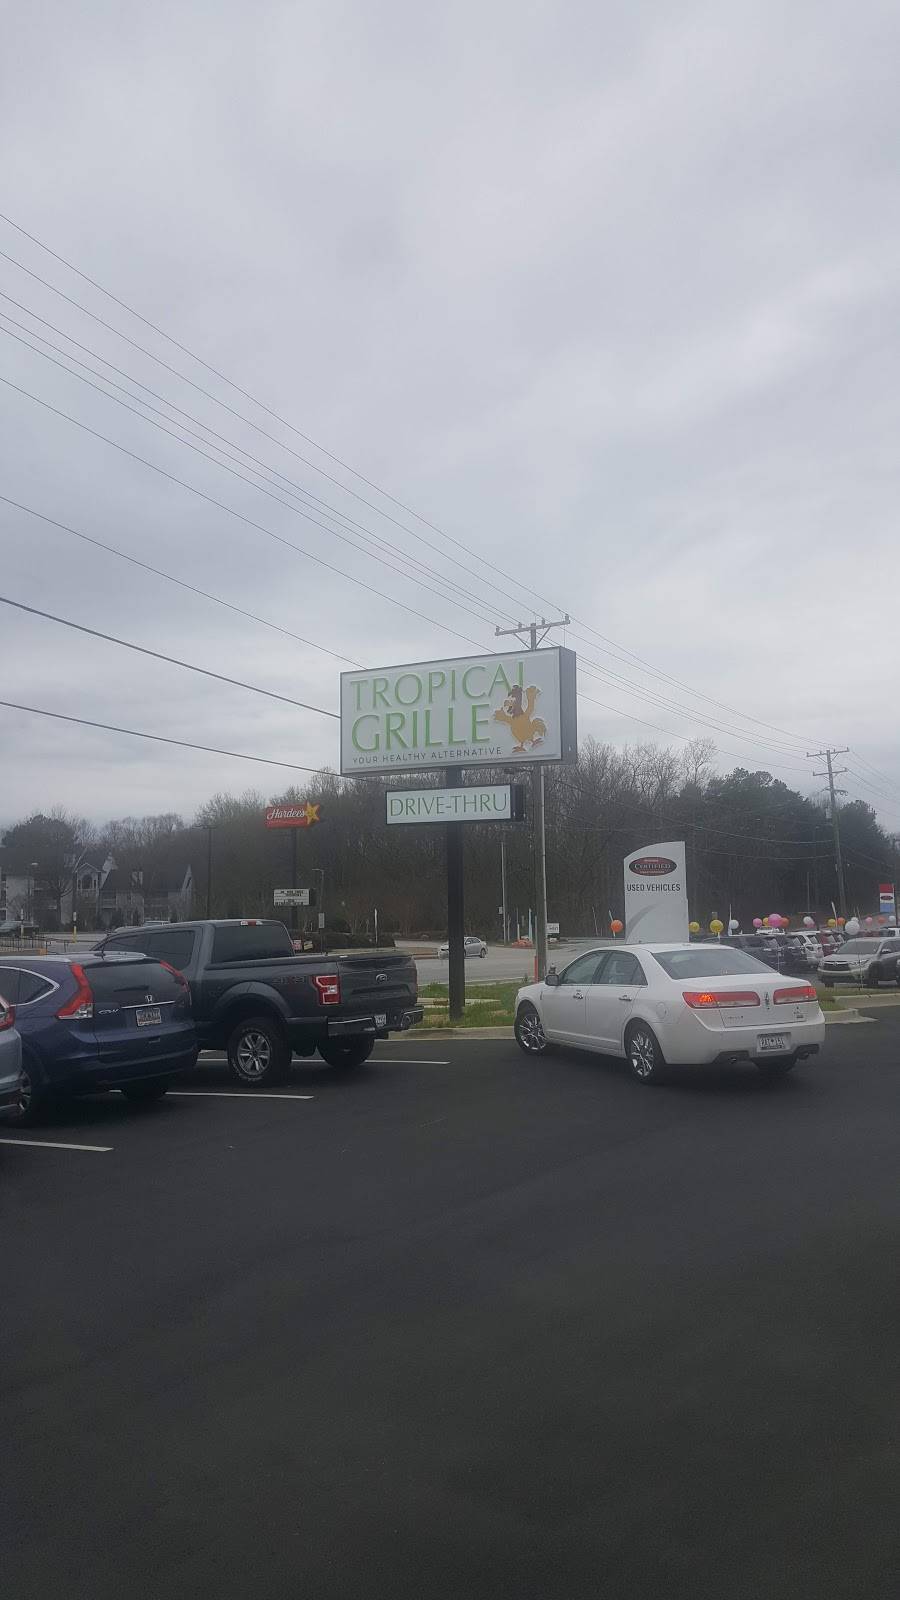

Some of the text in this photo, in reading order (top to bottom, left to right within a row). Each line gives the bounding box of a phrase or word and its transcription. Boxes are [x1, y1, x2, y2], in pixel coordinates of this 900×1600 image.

[352, 704, 490, 752] GRILLE
[352, 747, 502, 764] YOUR HEALTHY ALTERNATIVE
[390, 793, 507, 816] DRIVE-THRU
[627, 883, 681, 892] USED VEHICLES
